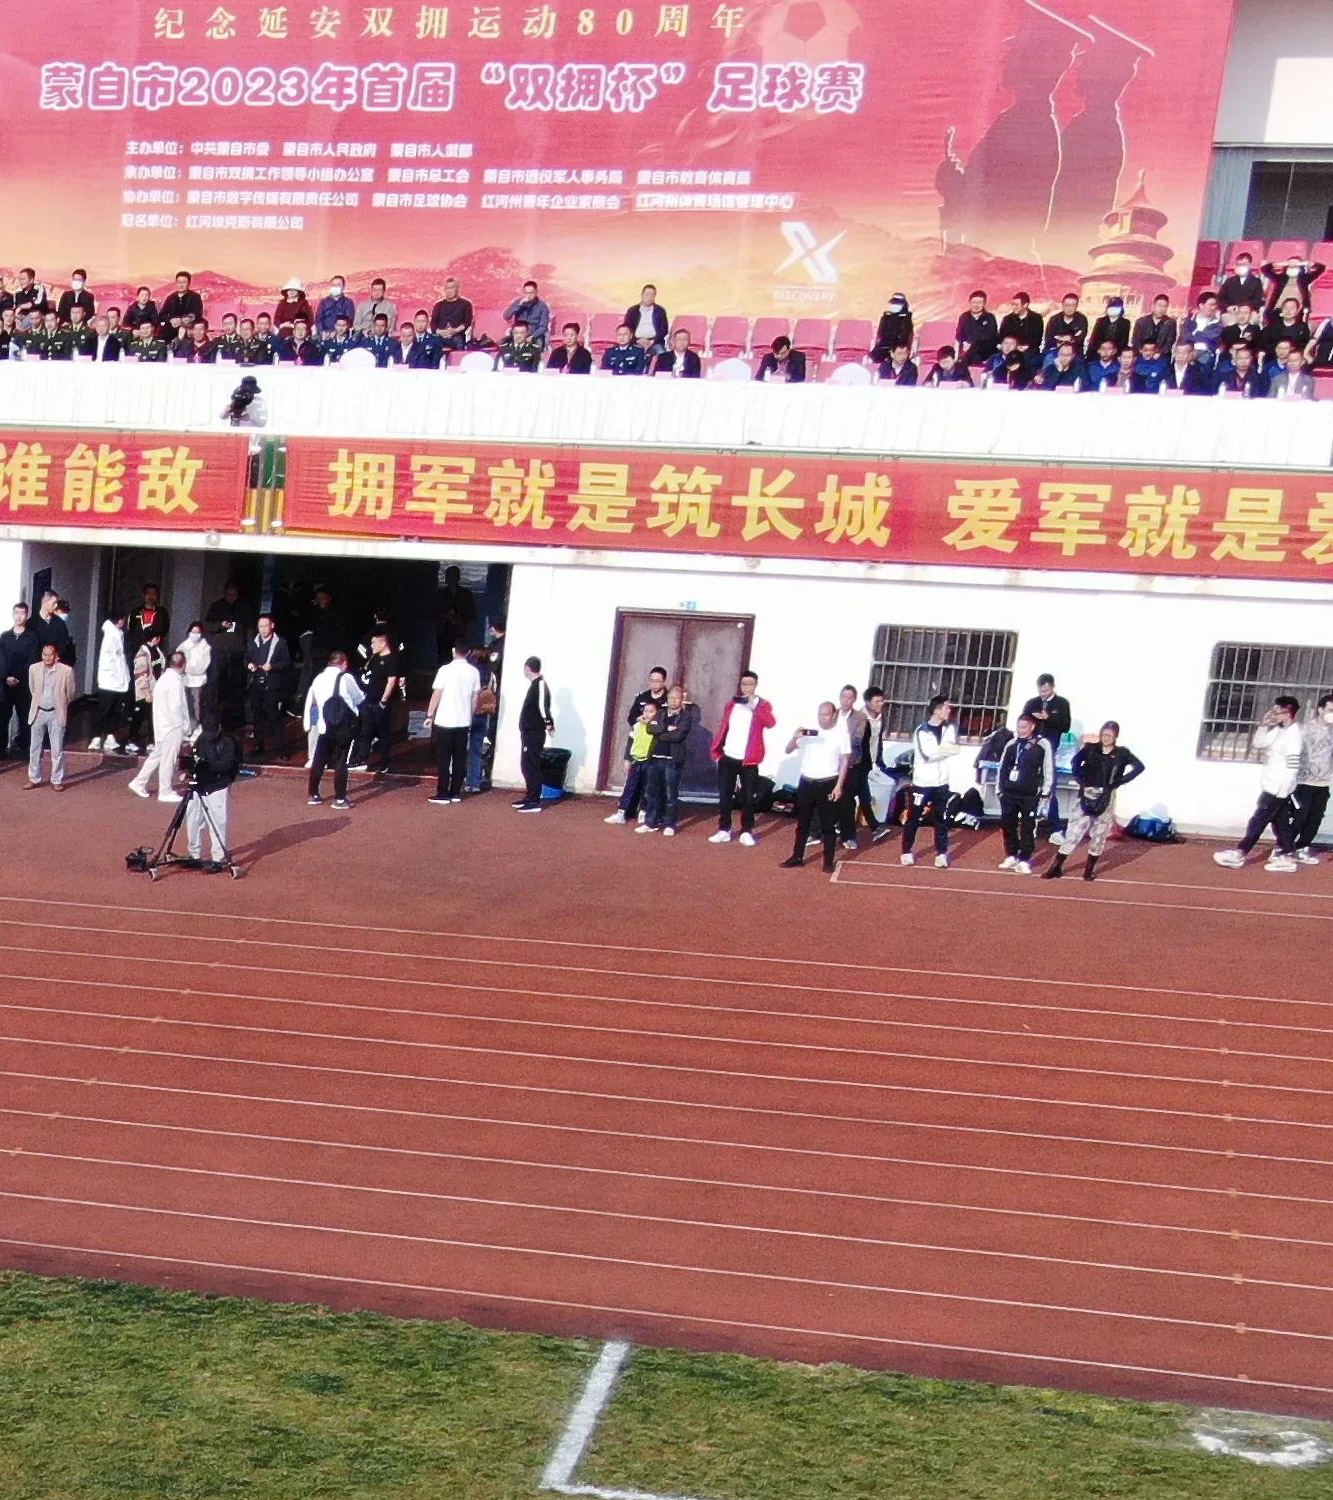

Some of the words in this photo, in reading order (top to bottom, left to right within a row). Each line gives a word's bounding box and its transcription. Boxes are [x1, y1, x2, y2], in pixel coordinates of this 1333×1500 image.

[154, 5, 744, 39] 纪念延安双拥运动80周年
[326, 446, 893, 547] 拥军就是筑长城
